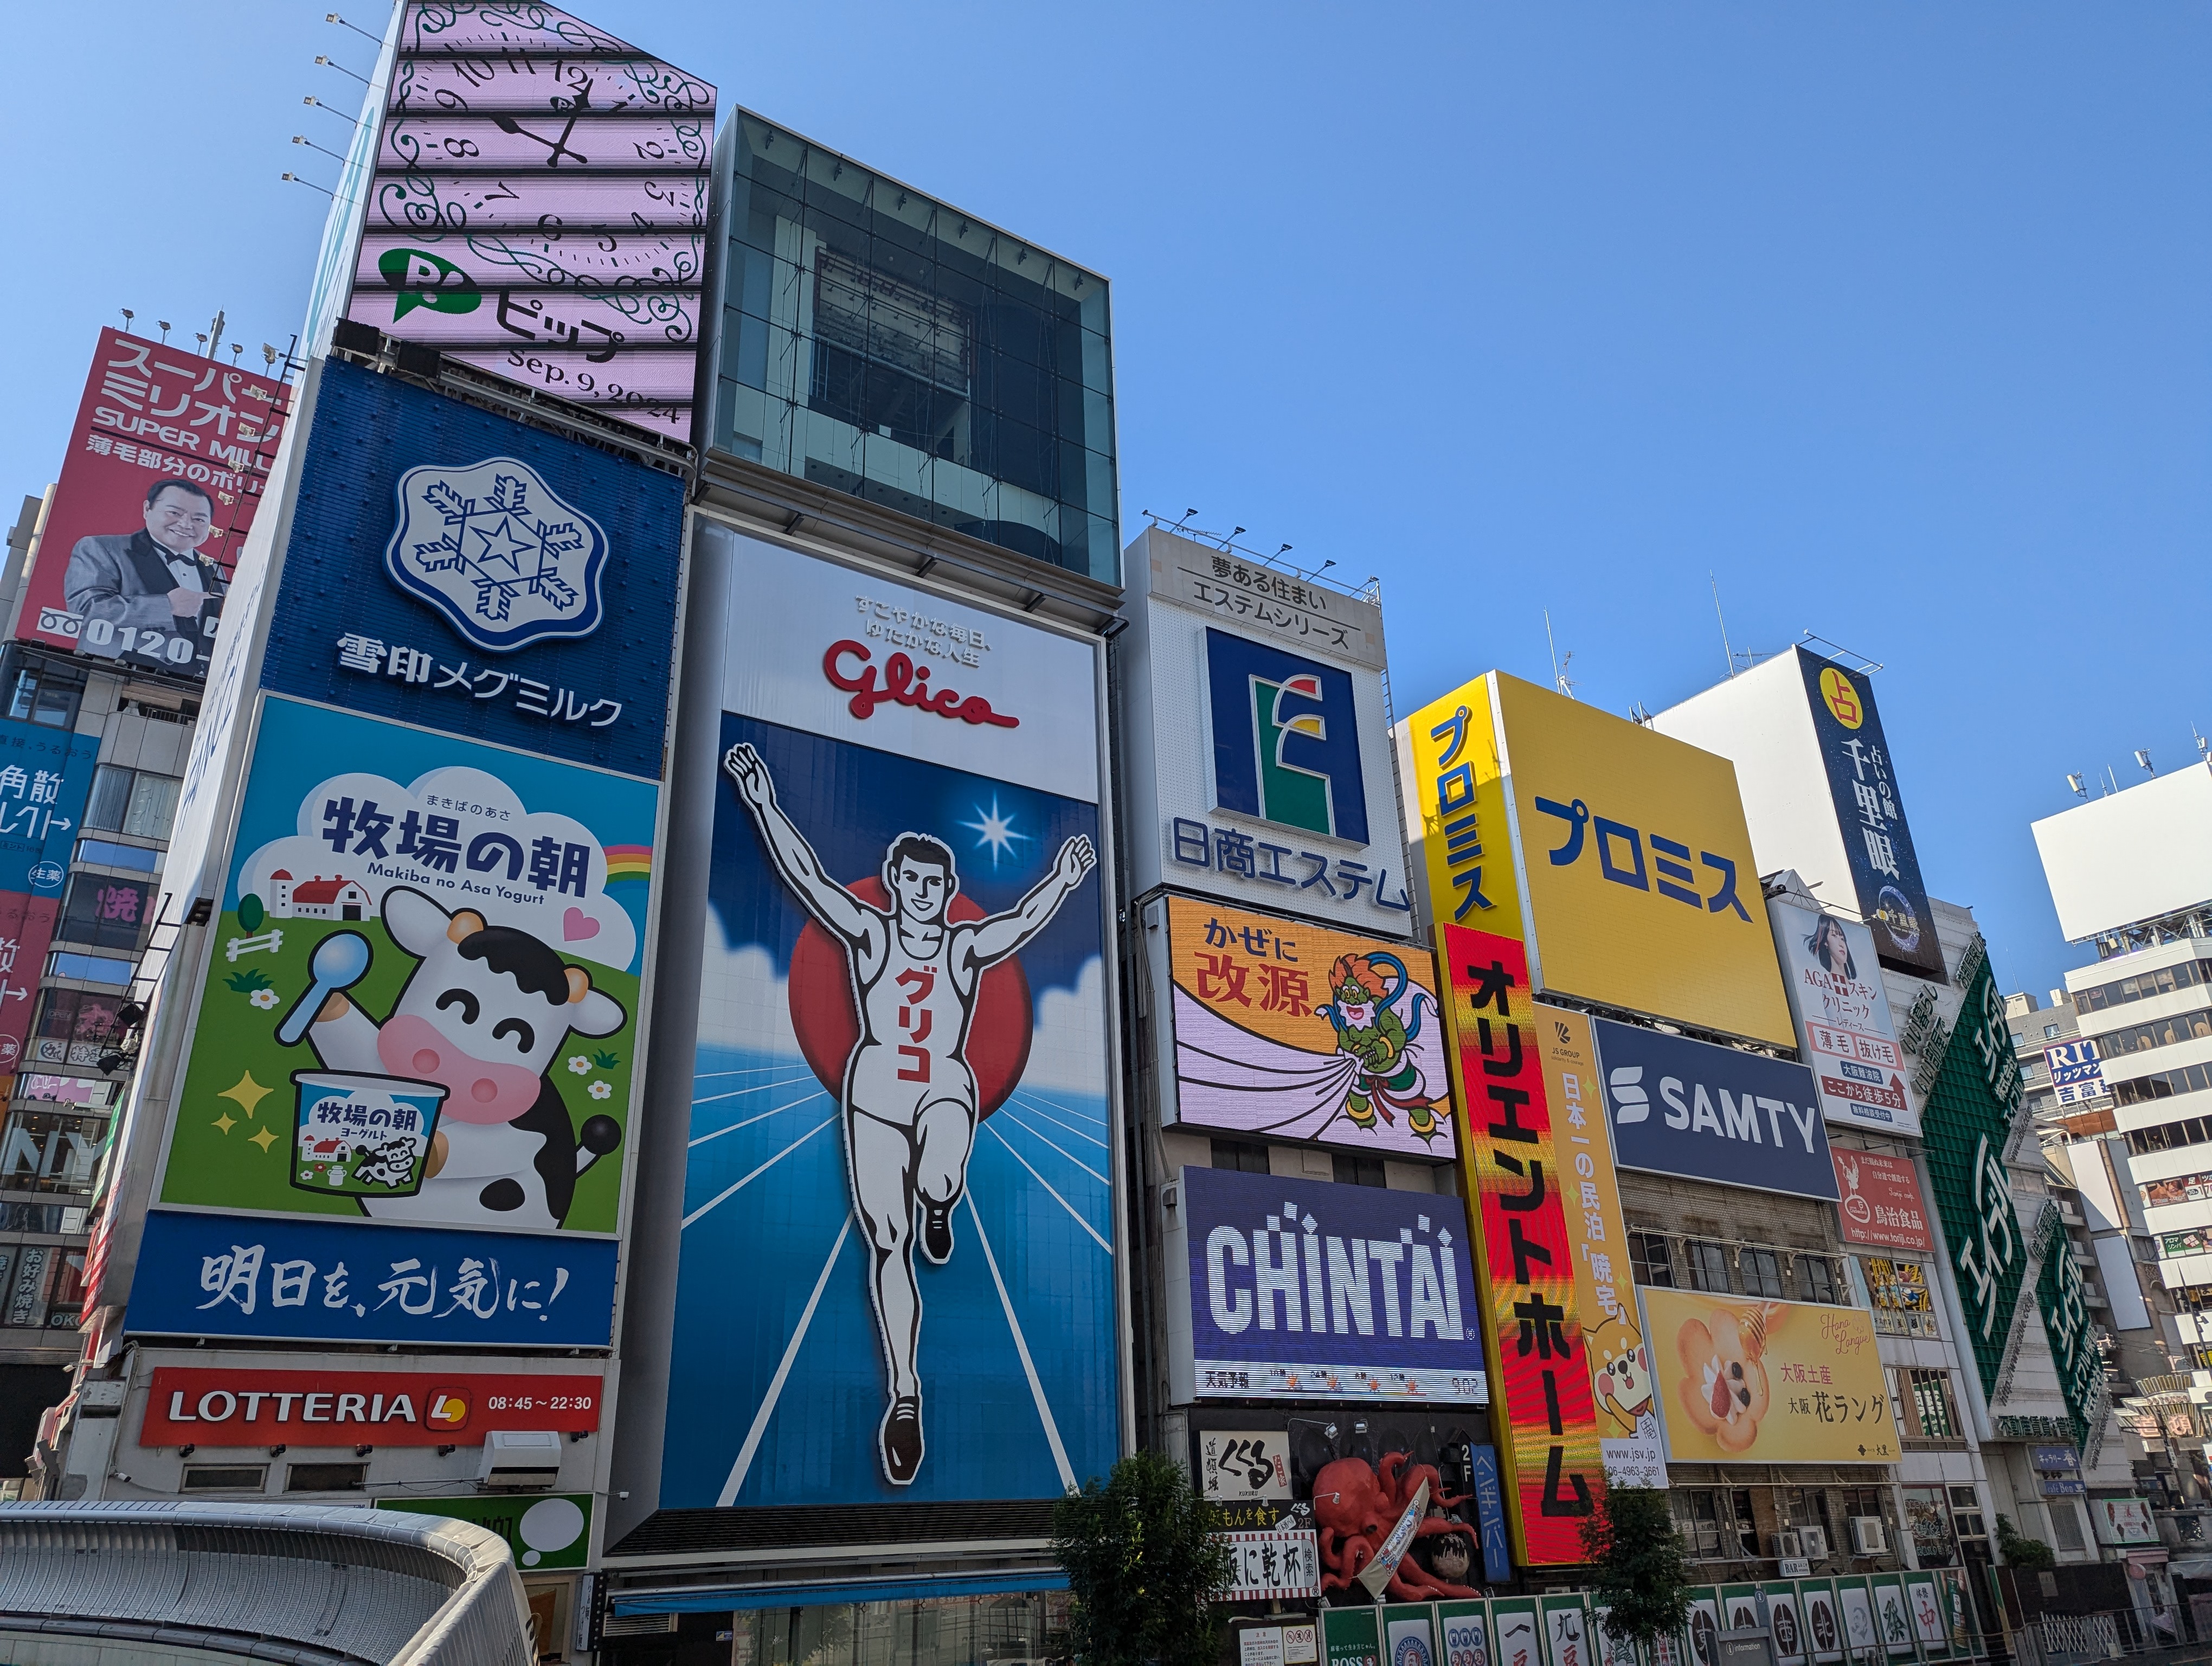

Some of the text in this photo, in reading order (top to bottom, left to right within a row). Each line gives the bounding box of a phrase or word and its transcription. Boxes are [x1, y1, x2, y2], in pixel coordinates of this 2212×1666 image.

[452, 54, 494, 88] 10
[501, 46, 536, 75] 11
[549, 59, 589, 91] 12
[434, 88, 469, 113] 9
[608, 98, 629, 115] 1
[443, 137, 480, 159] 8
[633, 140, 665, 161] 2
[484, 181, 520, 204] 7
[644, 181, 676, 208] 3
[538, 214, 563, 241] 6
[590, 223, 618, 253] 5
[631, 212, 654, 235] 4
[496, 291, 625, 363] ピップ
[108, 338, 280, 406] スーパー
[508, 348, 569, 386] Sep.
[607, 383, 680, 424] 2024
[101, 371, 279, 442] ミリオン
[92, 406, 200, 452] SUPER
[86, 434, 266, 492] 薄毛部分のボリ
[1212, 555, 1326, 610] 夢ある住まい
[856, 595, 993, 650] すこやかな毎日、
[1193, 581, 1349, 650] エステムシリーズ
[866, 619, 979, 668] ゆたかな人生
[337, 632, 622, 727] 雪印メグミルク
[824, 640, 1019, 728] Glico
[1830, 670, 1857, 723] 占
[1870, 745, 1898, 821] 占いの館
[426, 793, 511, 822] まきばのあさ
[1430, 706, 1496, 921] プロミス
[1841, 738, 1900, 881] 千里眼
[322, 795, 591, 899] 牧場の朝
[1535, 796, 1754, 924] プロミス
[1173, 817, 1410, 912] 日商エステム
[367, 862, 545, 907] Makiba no Asa Yogurt
[1204, 917, 1297, 962] かぜに
[1194, 952, 1313, 1017] 改源
[1804, 968, 1877, 1001] AGA スキン
[1823, 994, 1869, 1019] クリニック
[1902, 984, 1938, 1055] いい暮らし
[895, 965, 937, 1083] グリコ
[1836, 1017, 1864, 1032] レディース
[1975, 977, 2007, 1083] エイブル
[0, 1043, 17, 1055] 薬
[1560, 1048, 1580, 1059] GROUP
[1820, 1030, 1894, 1063] 薄毛 抜け毛
[1914, 1016, 1951, 1096] いい部屋で
[1843, 1065, 1881, 1082] 大阪難波院
[1994, 1053, 2018, 1103] 株式会社
[1827, 1080, 1902, 1108] ここから徒歩5分
[317, 1101, 417, 1132] 牧場の朝
[1660, 1075, 1815, 1154] SAMTY
[1853, 1105, 1891, 1121] 無料相談受付中
[340, 1126, 388, 1142] ヨーグルト
[1875, 1205, 1923, 1230] 鳥治食品
[1467, 960, 1592, 1517] オリエントホーム
[1851, 1227, 1925, 1247] http://www.toriji.co.jp/
[1960, 1133, 2012, 1343] エイブル
[12, 1248, 44, 1324] お好み焼き
[2050, 1242, 2083, 1373] エイブル
[1821, 1313, 1850, 1339] Hana
[1835, 1330, 1870, 1355] Langue
[1205, 1371, 1249, 1389] 天気予報
[1780, 1363, 1832, 1385] 大阪土産
[169, 1390, 417, 1423] LOTTERIA
[1788, 1391, 1884, 1424] 大阪 花ラング
[1206, 1438, 1219, 1491] 道頓堀
[1218, 1439, 1274, 1489] くくる
[1606, 1447, 1655, 1462] www.jsv.jp
[1609, 1466, 1660, 1476] 06-4963-3661
[2060, 1482, 2073, 1492] Bon
[1298, 1518, 1311, 1528] 2F
[1477, 1456, 1503, 1568] ペンギンバー
[1304, 1548, 1314, 1577] 検索
[1784, 1564, 1798, 1573] BAR
[1918, 1600, 1935, 1641] 中
[1734, 1643, 1760, 1651] information
